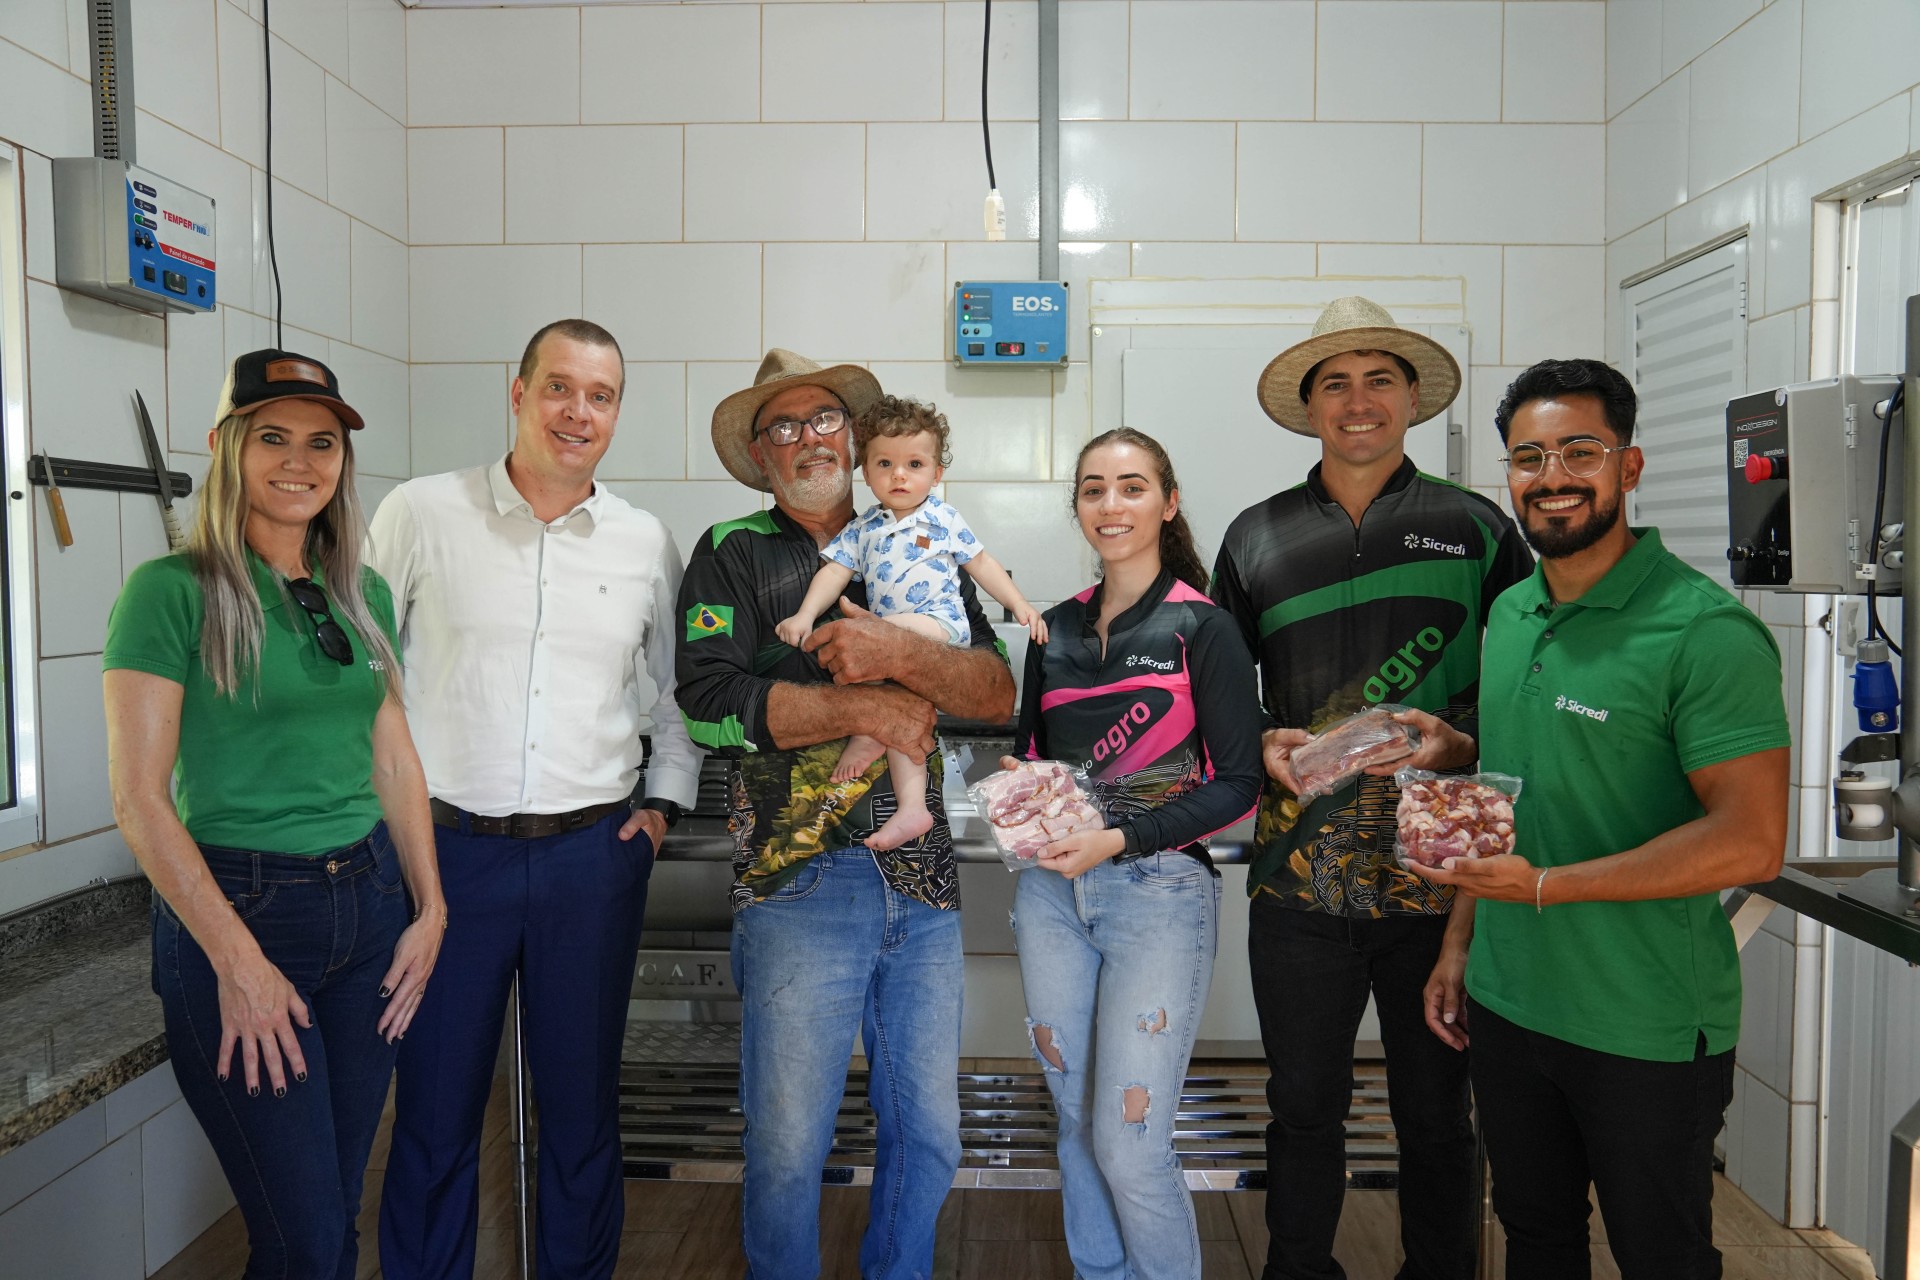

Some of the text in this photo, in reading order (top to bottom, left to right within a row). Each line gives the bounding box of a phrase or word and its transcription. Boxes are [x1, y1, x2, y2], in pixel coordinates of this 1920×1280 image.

[1422, 537, 1466, 556] Sicredi
[1138, 656, 1175, 671] Sicredi
[1363, 626, 1444, 704] agro
[1566, 699, 1609, 722] Sicredi
[1093, 701, 1151, 762] agro
[806, 798, 838, 837] Juntos
[638, 963, 724, 986] C.A.F.
